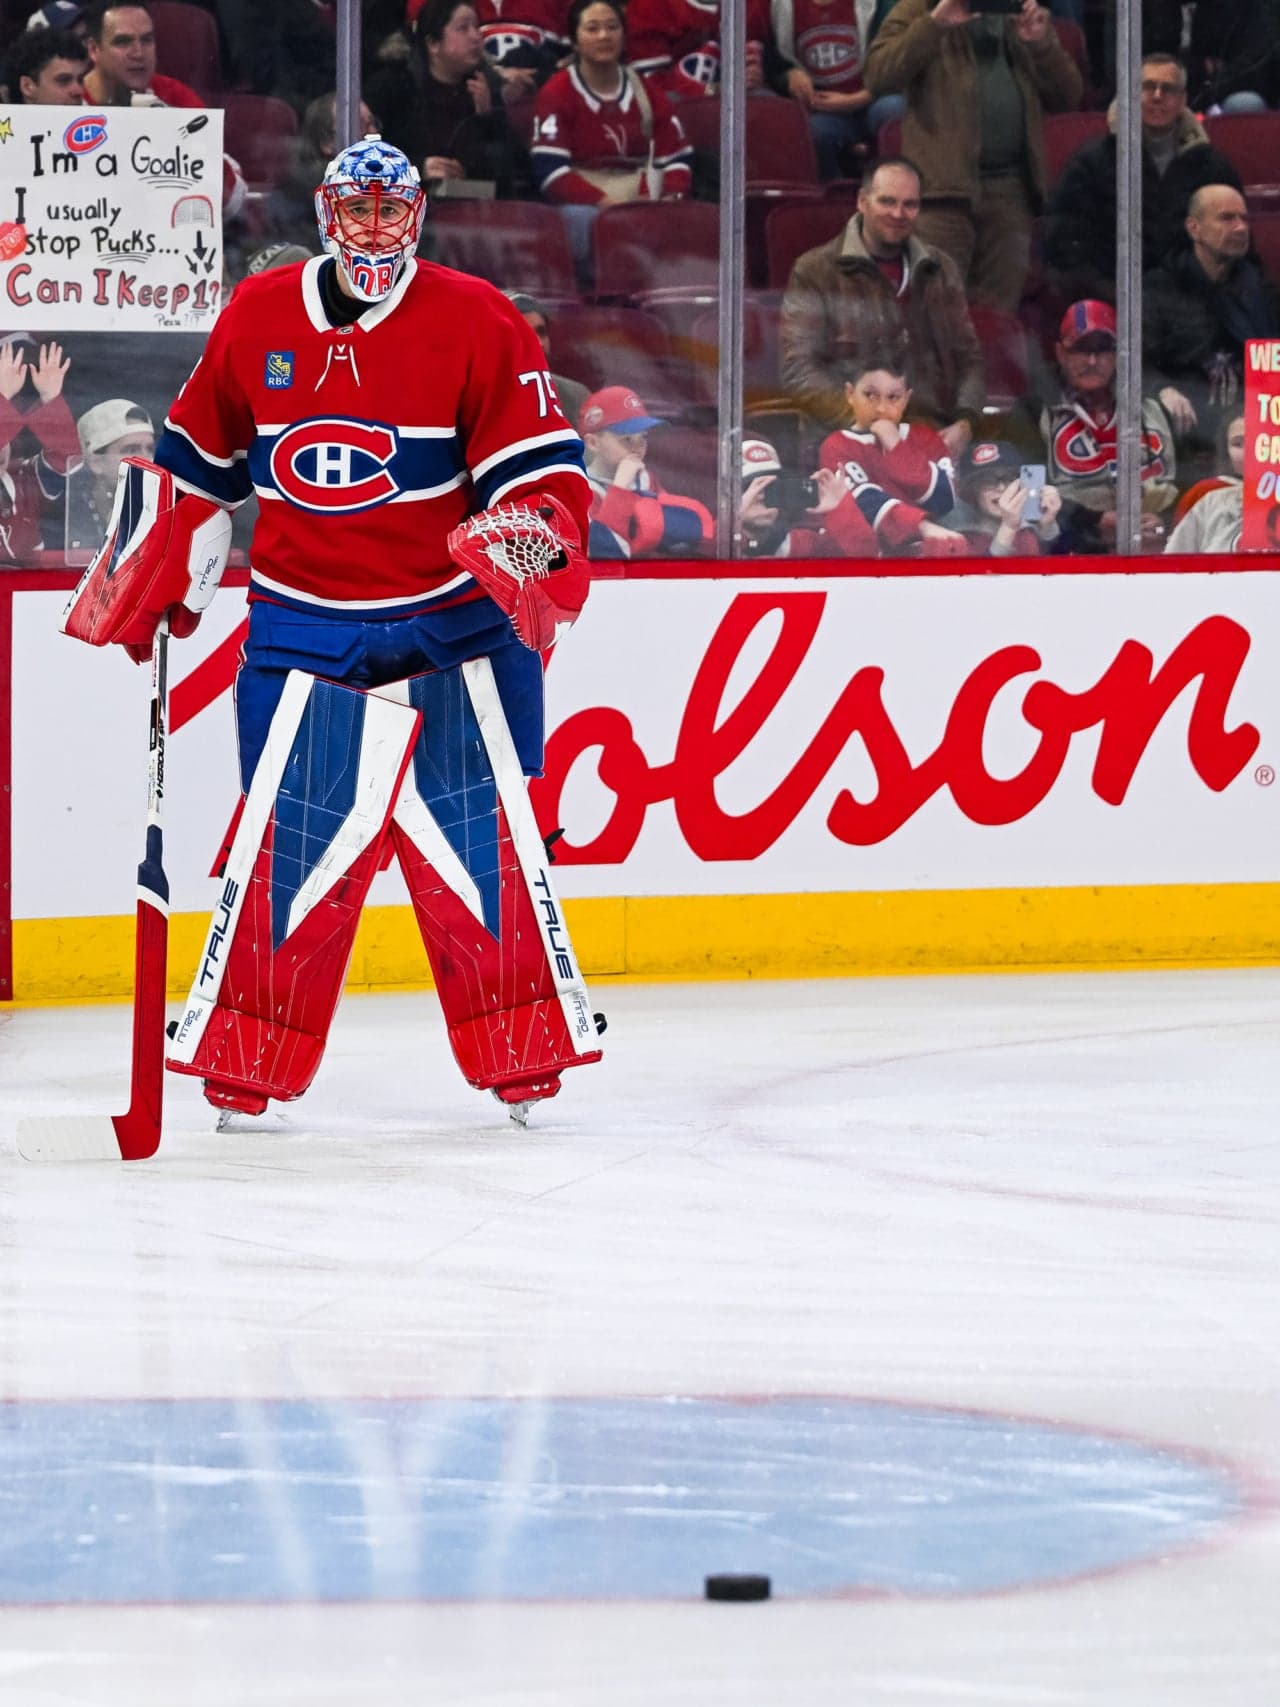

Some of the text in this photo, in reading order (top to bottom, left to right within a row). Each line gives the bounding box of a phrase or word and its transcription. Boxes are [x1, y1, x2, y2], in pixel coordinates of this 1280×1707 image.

[30, 130, 205, 180] I'm a Goalie
[15, 187, 122, 227] I usually
[24, 227, 81, 260] stop
[6, 263, 83, 307] Can
[93, 268, 112, 306] I
[117, 270, 190, 315] Keep
[268, 377, 289, 386] RBC
[169, 591, 1260, 878] olson
[199, 877, 240, 988] TRUE
[533, 868, 575, 980] TRUE
